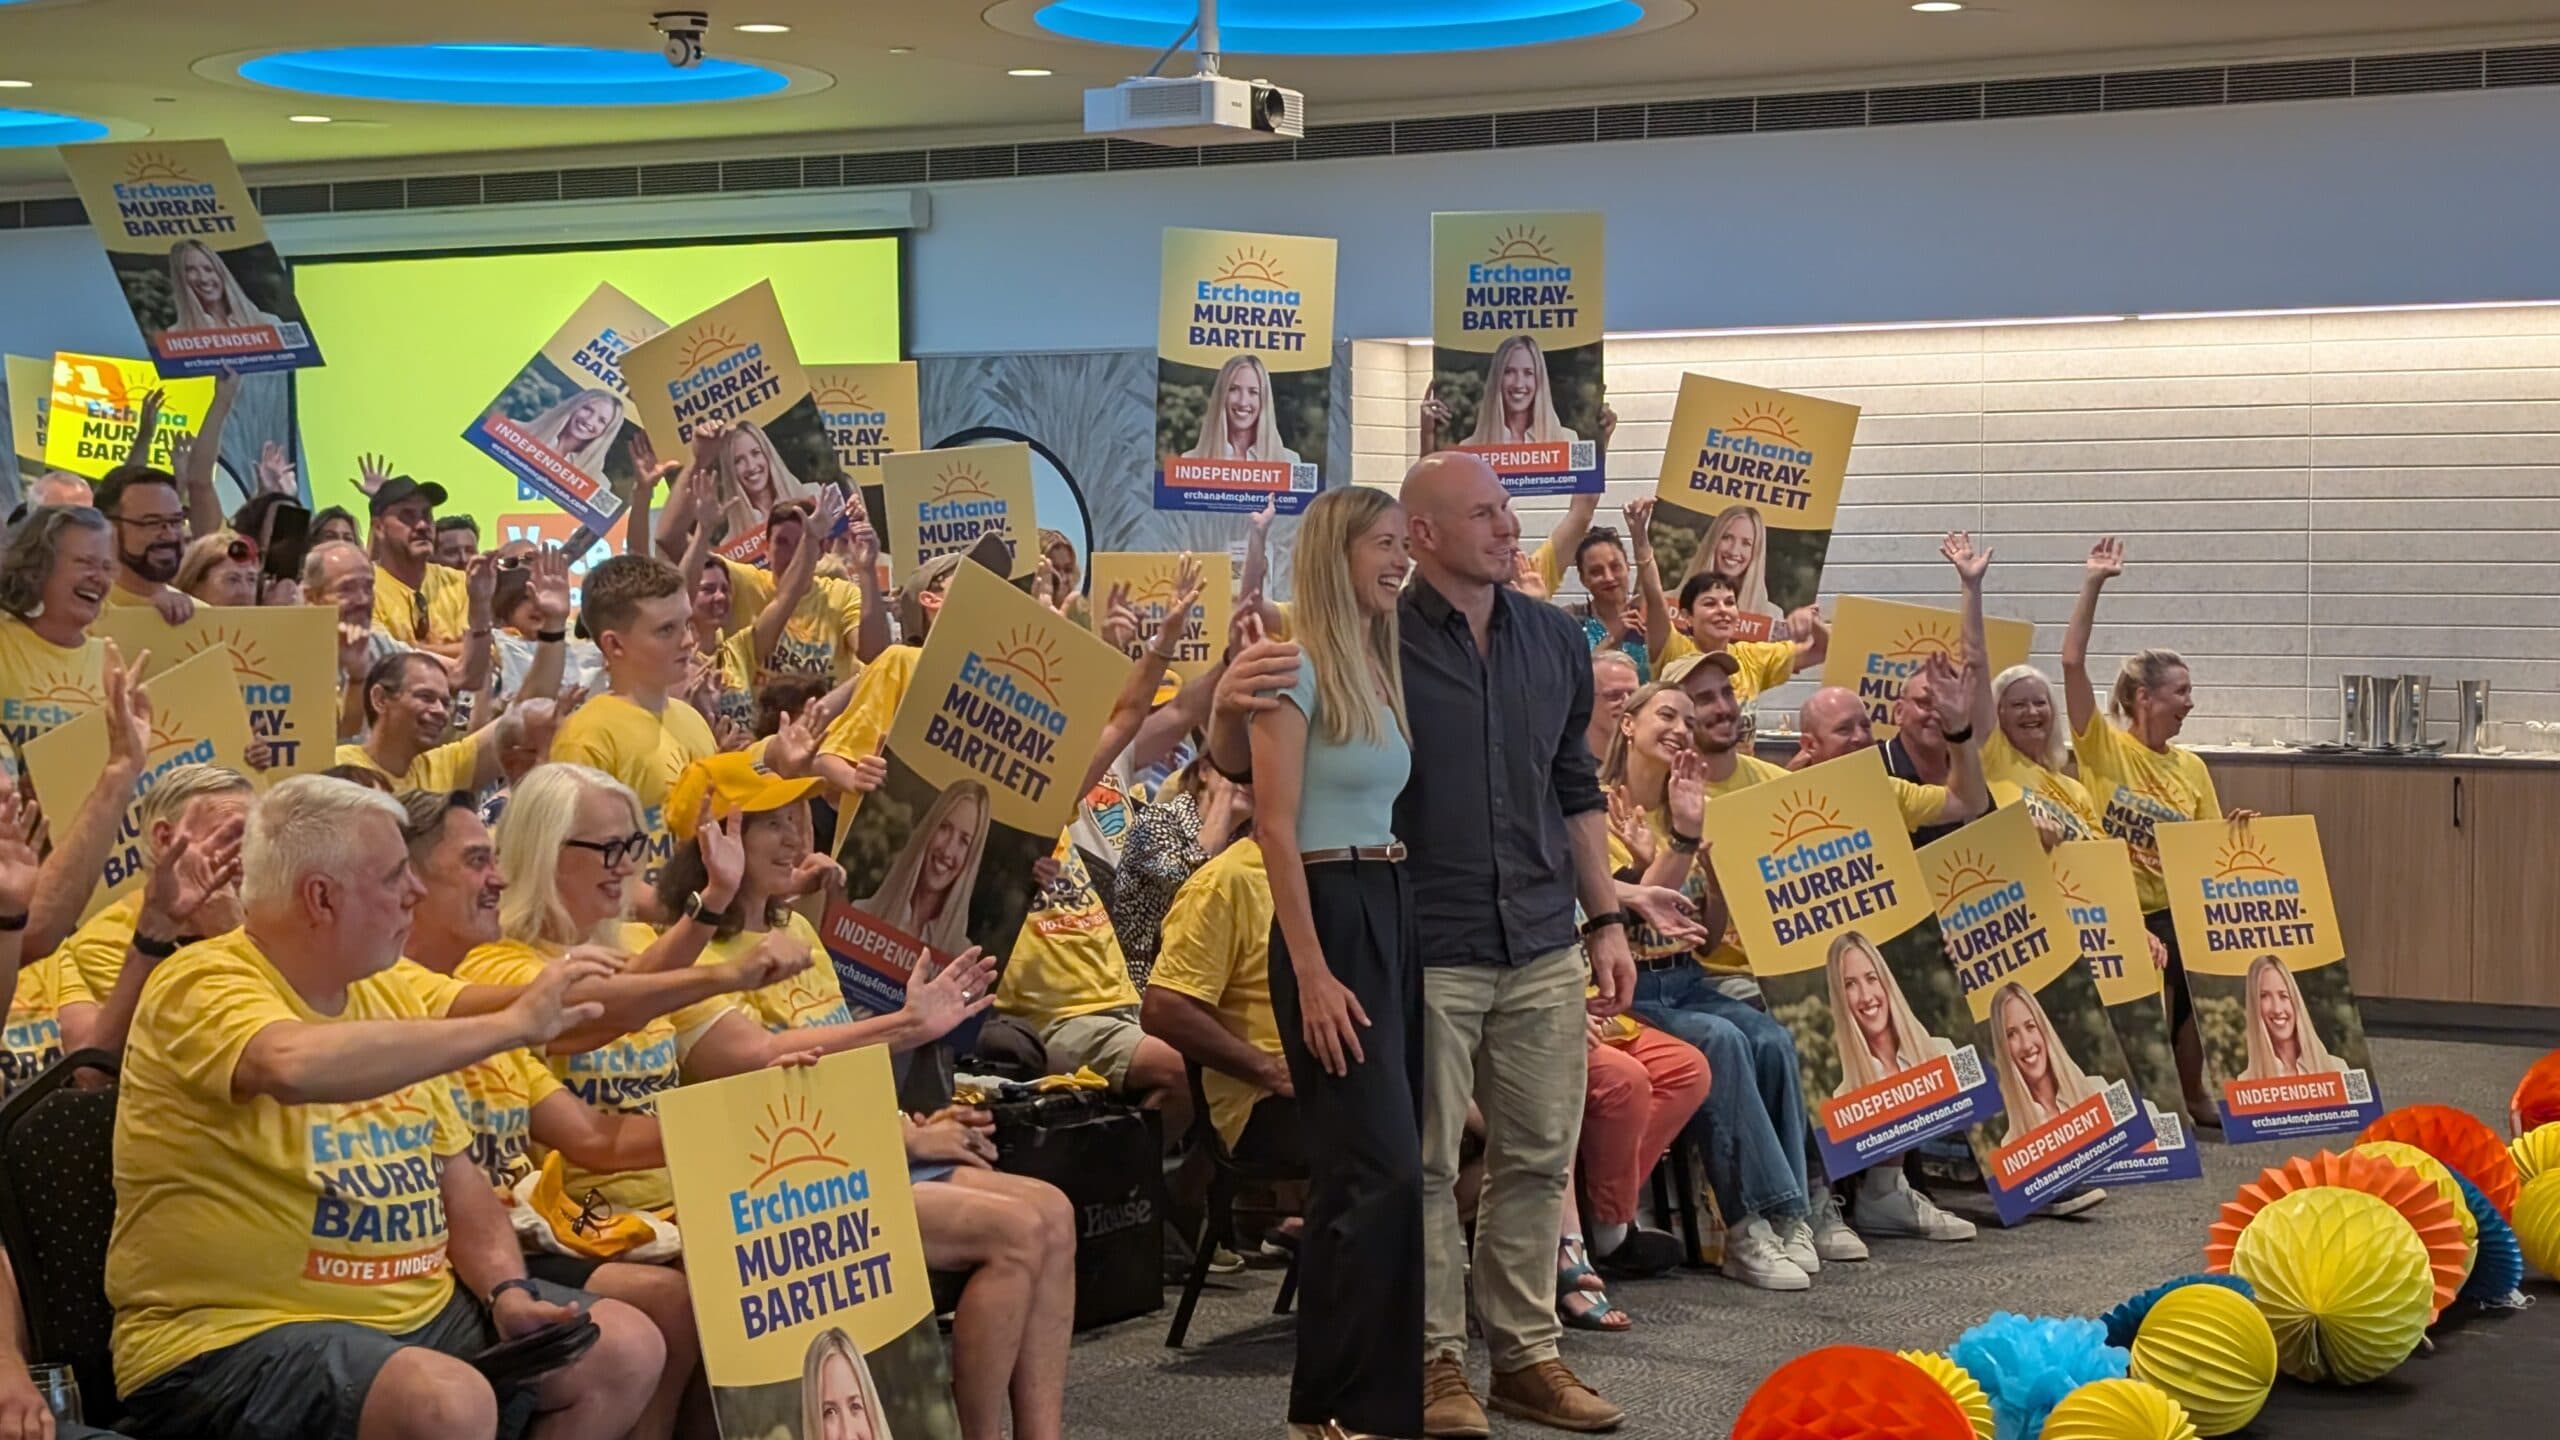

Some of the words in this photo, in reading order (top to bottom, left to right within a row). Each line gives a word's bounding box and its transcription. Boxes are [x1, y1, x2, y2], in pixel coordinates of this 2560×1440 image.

[112, 182, 216, 200] Erchana
[119, 199, 225, 218] MURRAY-
[124, 216, 236, 237] BARTLETT
[1469, 262, 1571, 285] Erchana
[1197, 280, 1300, 306] Erchana
[1466, 284, 1574, 308] MURRAY-
[1193, 303, 1302, 328] MURRAY-
[1462, 307, 1578, 331] BARTLETT
[166, 331, 271, 351] INDEPENDENT
[1189, 326, 1306, 351] BARTLETT
[667, 342, 762, 400] Erchana
[673, 360, 771, 422] MURRAY-
[495, 423, 589, 490] INDEPENDENT
[1705, 428, 1813, 466] Erchana
[1175, 465, 1282, 484] INDEPENDENT
[1698, 449, 1811, 486] MURRAY-
[1689, 471, 1812, 511] BARTLETT
[919, 500, 1007, 522] Erchana
[960, 651, 1067, 737] Erchana
[943, 683, 1055, 764] MURRAY-
[925, 715, 1050, 802] BARTLETT
[1757, 829, 1872, 883] Erchana
[1765, 852, 1884, 915] MURRAY-
[2202, 876, 2299, 902] Erchana
[1772, 880, 1897, 947] BARTLETT
[2205, 898, 2306, 925] MURRAY-
[1953, 904, 2036, 962] URRAY-
[2207, 922, 2314, 952] BARTLETT
[1959, 927, 2050, 995] ARTLETT
[1833, 1069, 1944, 1129] INDEPENDENT
[2236, 1081, 2336, 1106] INDEPENDENT
[1856, 1097, 1973, 1152] erchana4mcpherson.com
[2252, 1109, 2359, 1128] erchana4mcpherson.com
[2003, 1106, 2101, 1176] INDEPENDENT
[2024, 1130, 2127, 1196] erchana4mcpherson.com
[729, 1169, 869, 1235] Erchana
[734, 1208, 880, 1286] MURRAY-
[317, 1256, 376, 1280] VOTE
[380, 1261, 390, 1279] 1
[739, 1253, 893, 1340] BARTLETT
